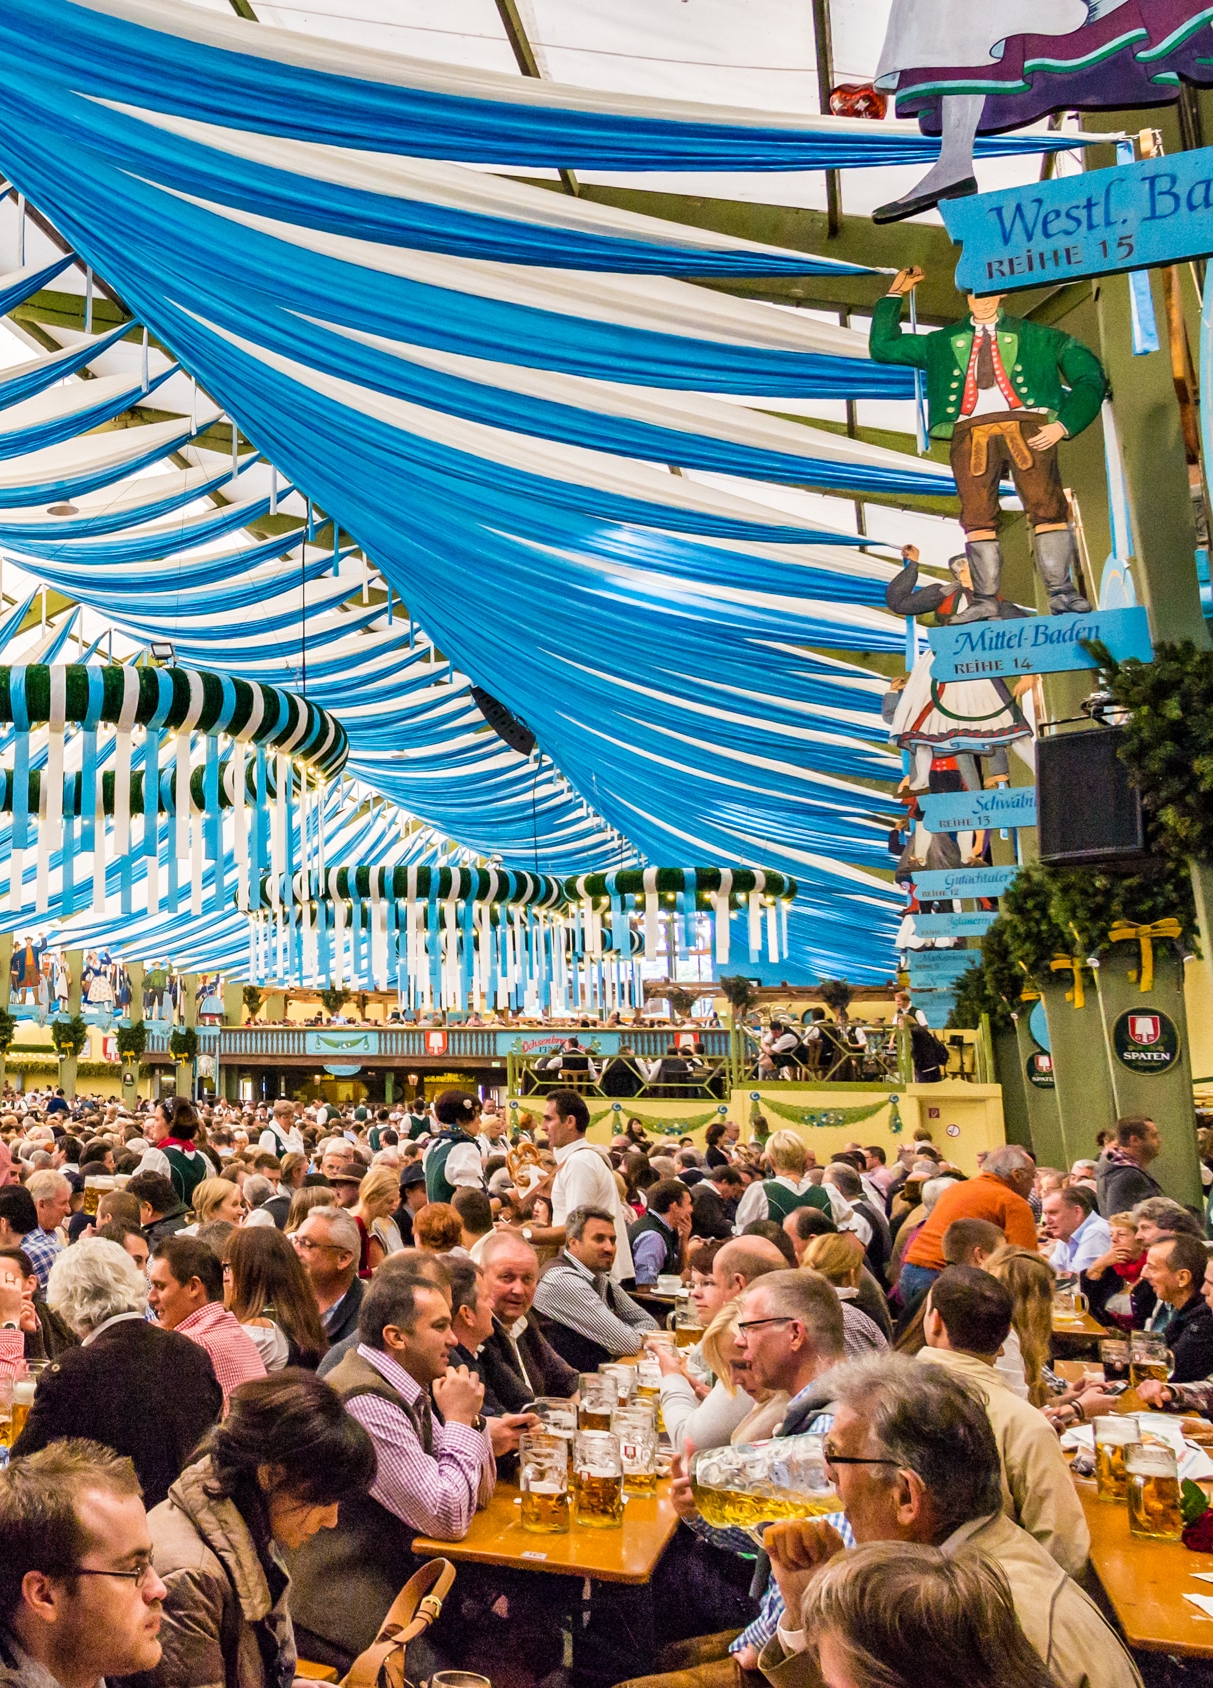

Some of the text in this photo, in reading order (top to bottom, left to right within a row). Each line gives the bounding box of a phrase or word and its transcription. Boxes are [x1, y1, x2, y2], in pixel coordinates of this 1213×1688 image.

[988, 177, 1128, 247] Westl.
[1098, 234, 1134, 261] 15
[1013, 657, 1033, 670] 14
[977, 815, 991, 827] 13
[1123, 1051, 1171, 1061] SPATEN
